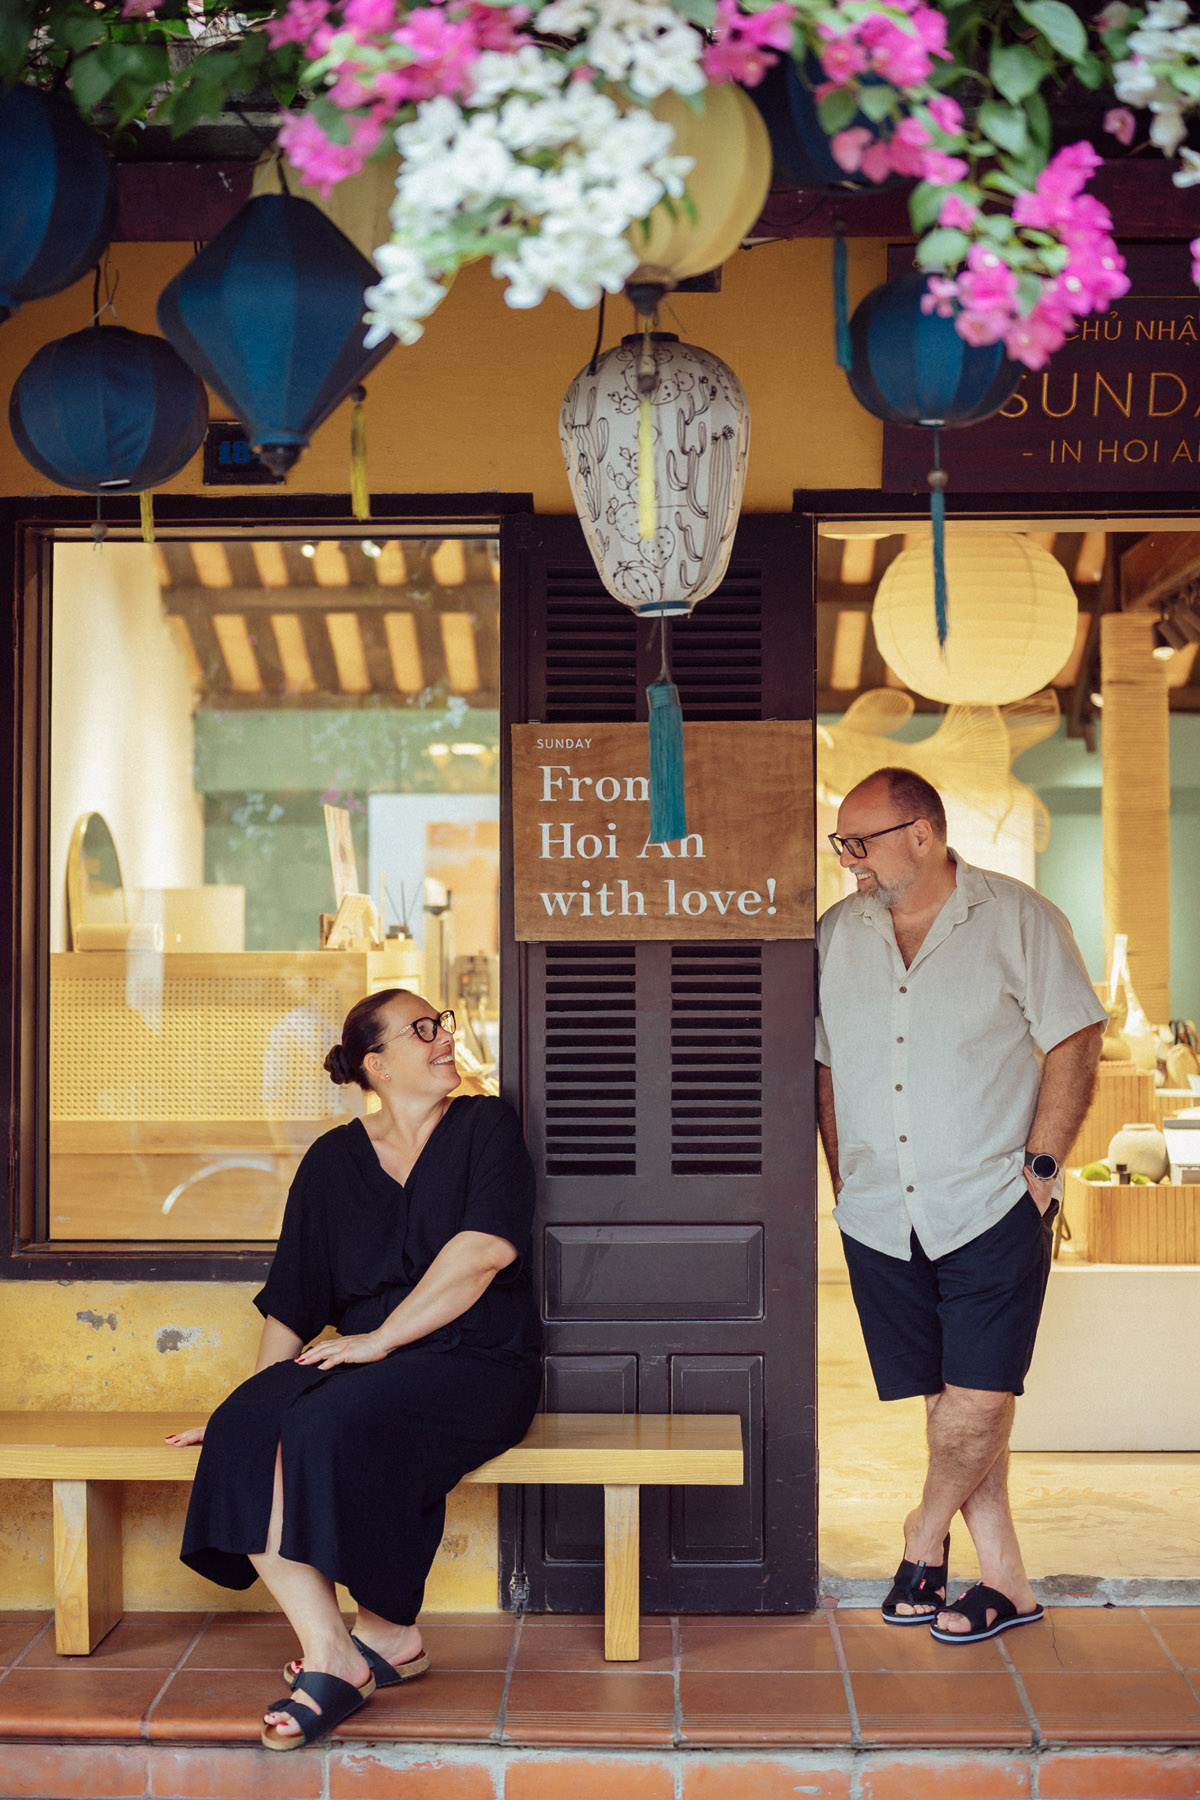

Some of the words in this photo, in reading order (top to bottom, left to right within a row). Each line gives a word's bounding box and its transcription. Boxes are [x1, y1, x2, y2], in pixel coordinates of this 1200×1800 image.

[999, 371, 1200, 418] SUND
[218, 440, 267, 465] 18
[1050, 439, 1082, 463] IN
[1098, 439, 1159, 463] HOI
[536, 738, 592, 749] SUNDAY
[537, 822, 620, 860] Hoi
[538, 879, 648, 917] with
[663, 877, 777, 917] love!
